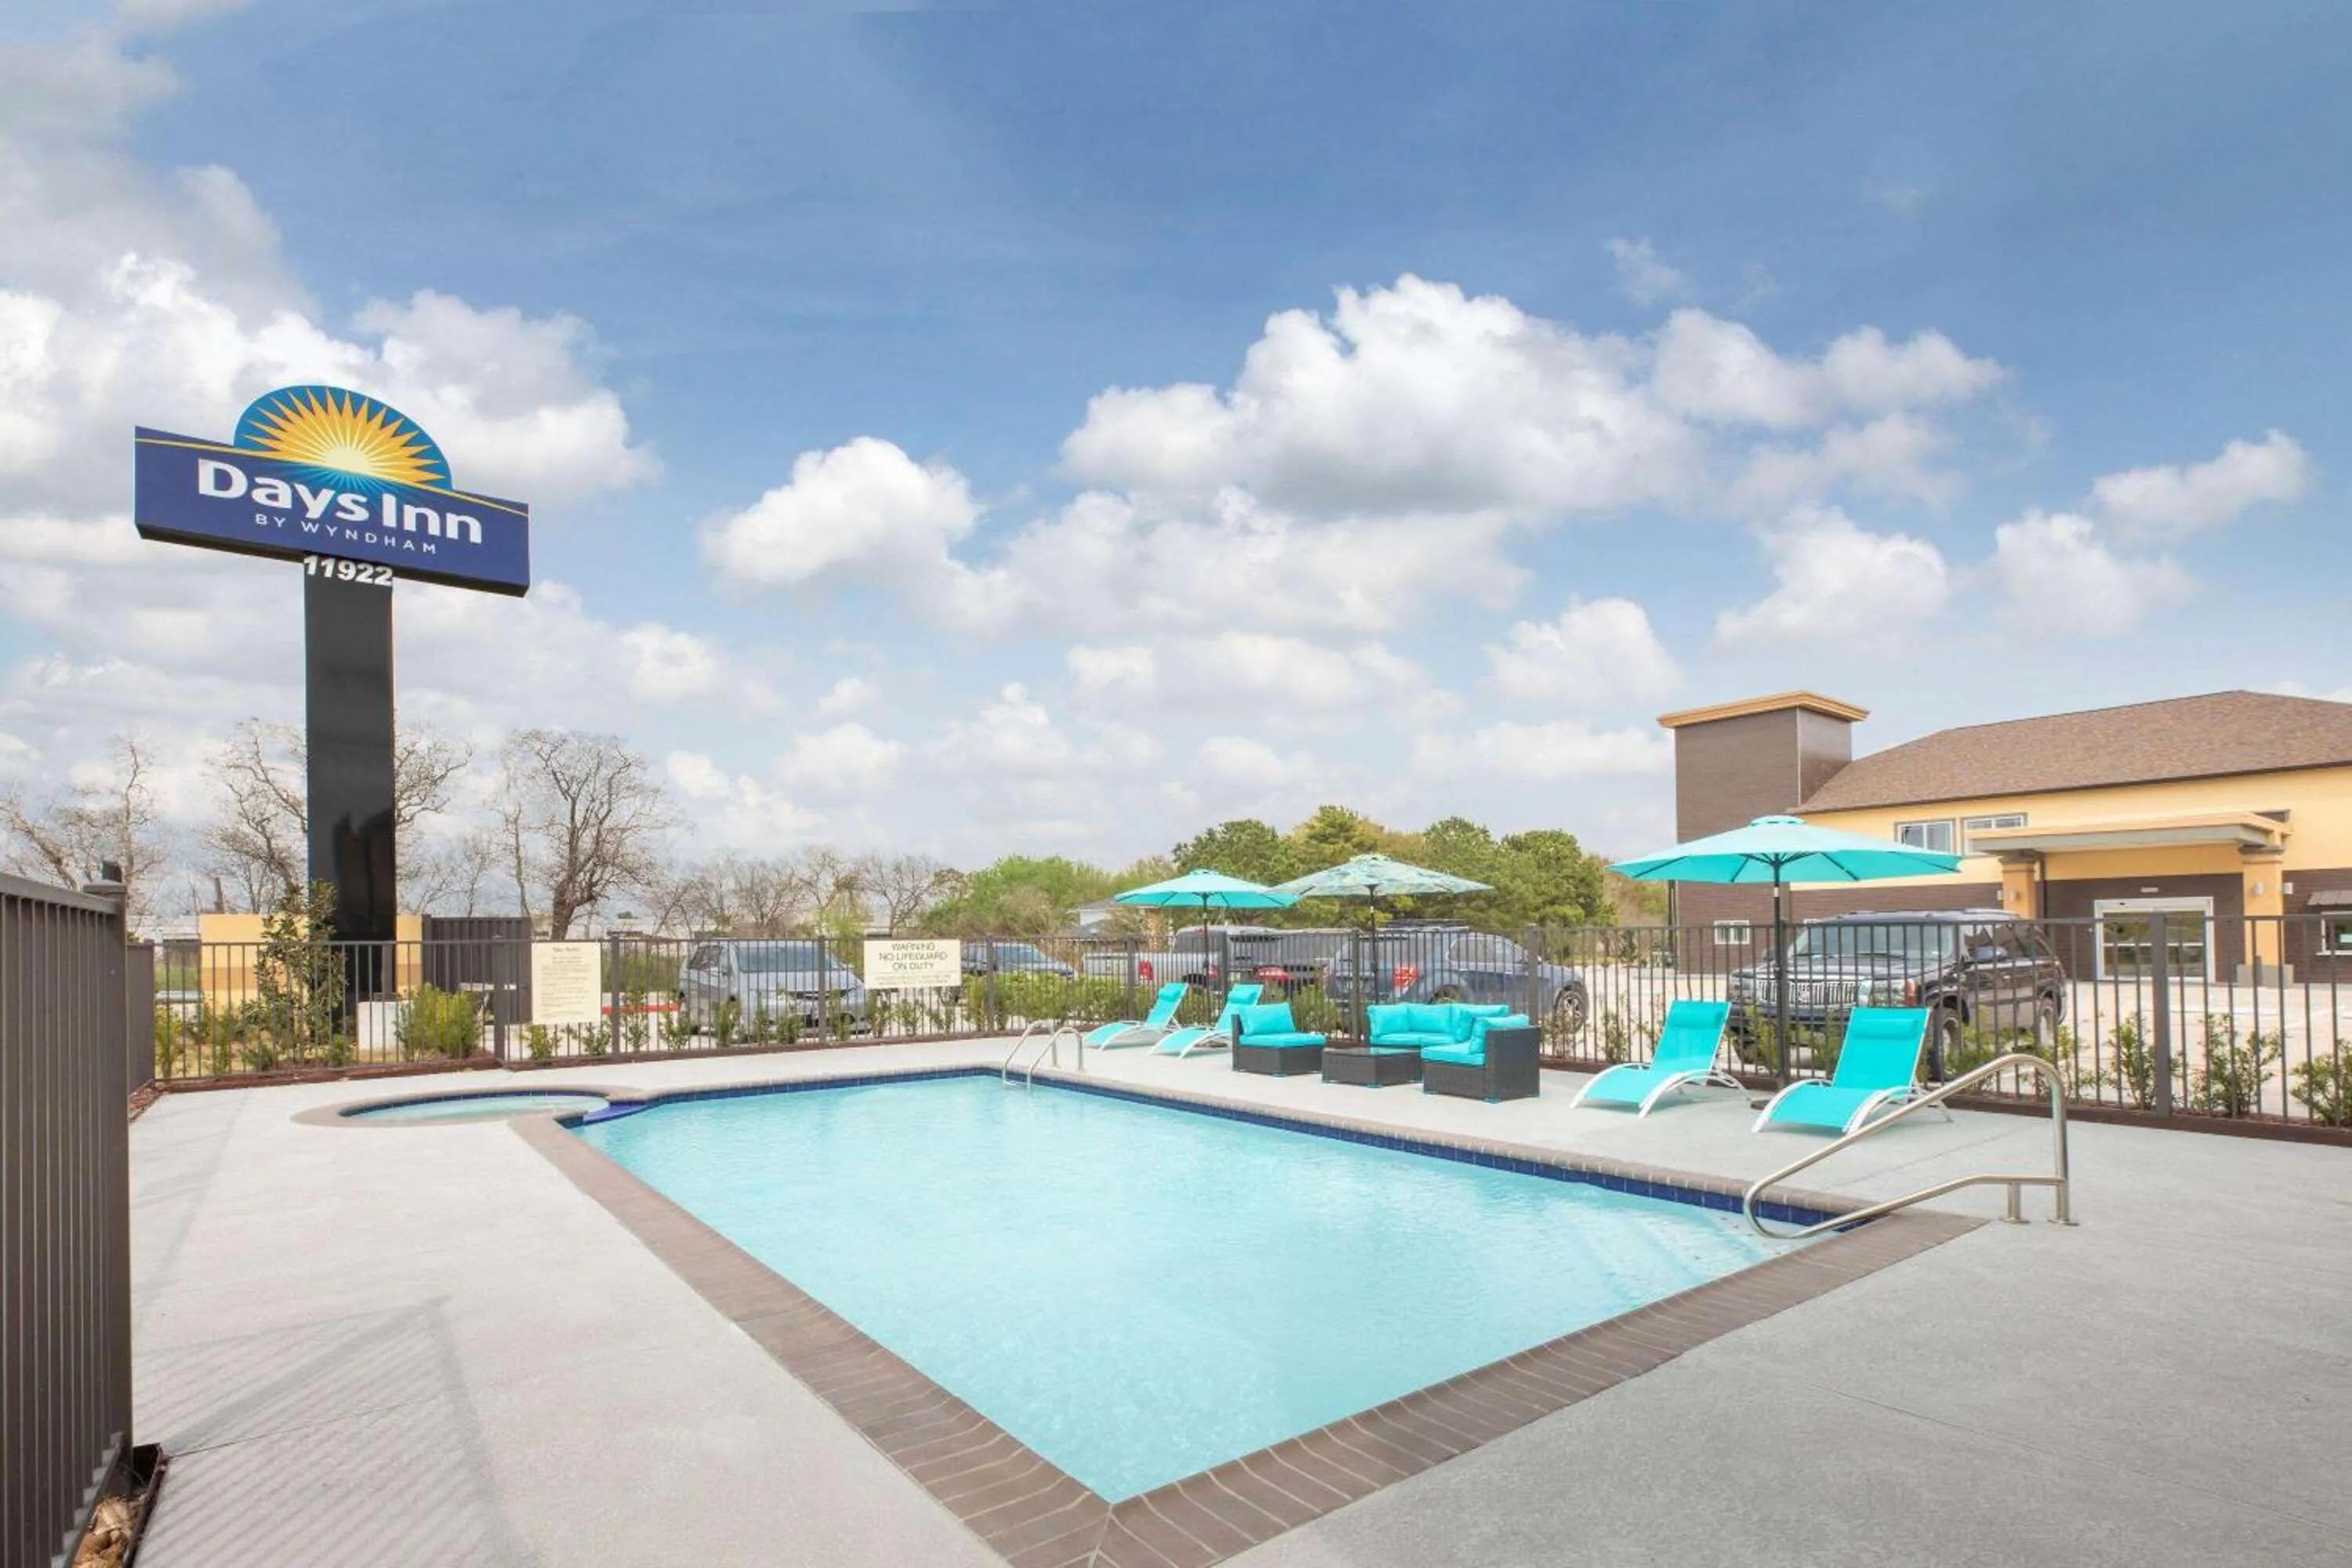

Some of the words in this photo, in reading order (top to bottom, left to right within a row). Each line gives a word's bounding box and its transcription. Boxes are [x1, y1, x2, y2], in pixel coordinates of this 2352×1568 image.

[197, 459, 370, 521] Days
[383, 494, 482, 544] Inn
[256, 514, 285, 528] BY
[301, 521, 437, 555] WYNDHAM
[304, 555, 393, 586] 11922
[892, 942, 935, 951] WARNING
[896, 951, 947, 960] LIFEGUARD
[892, 962, 907, 971] ON
